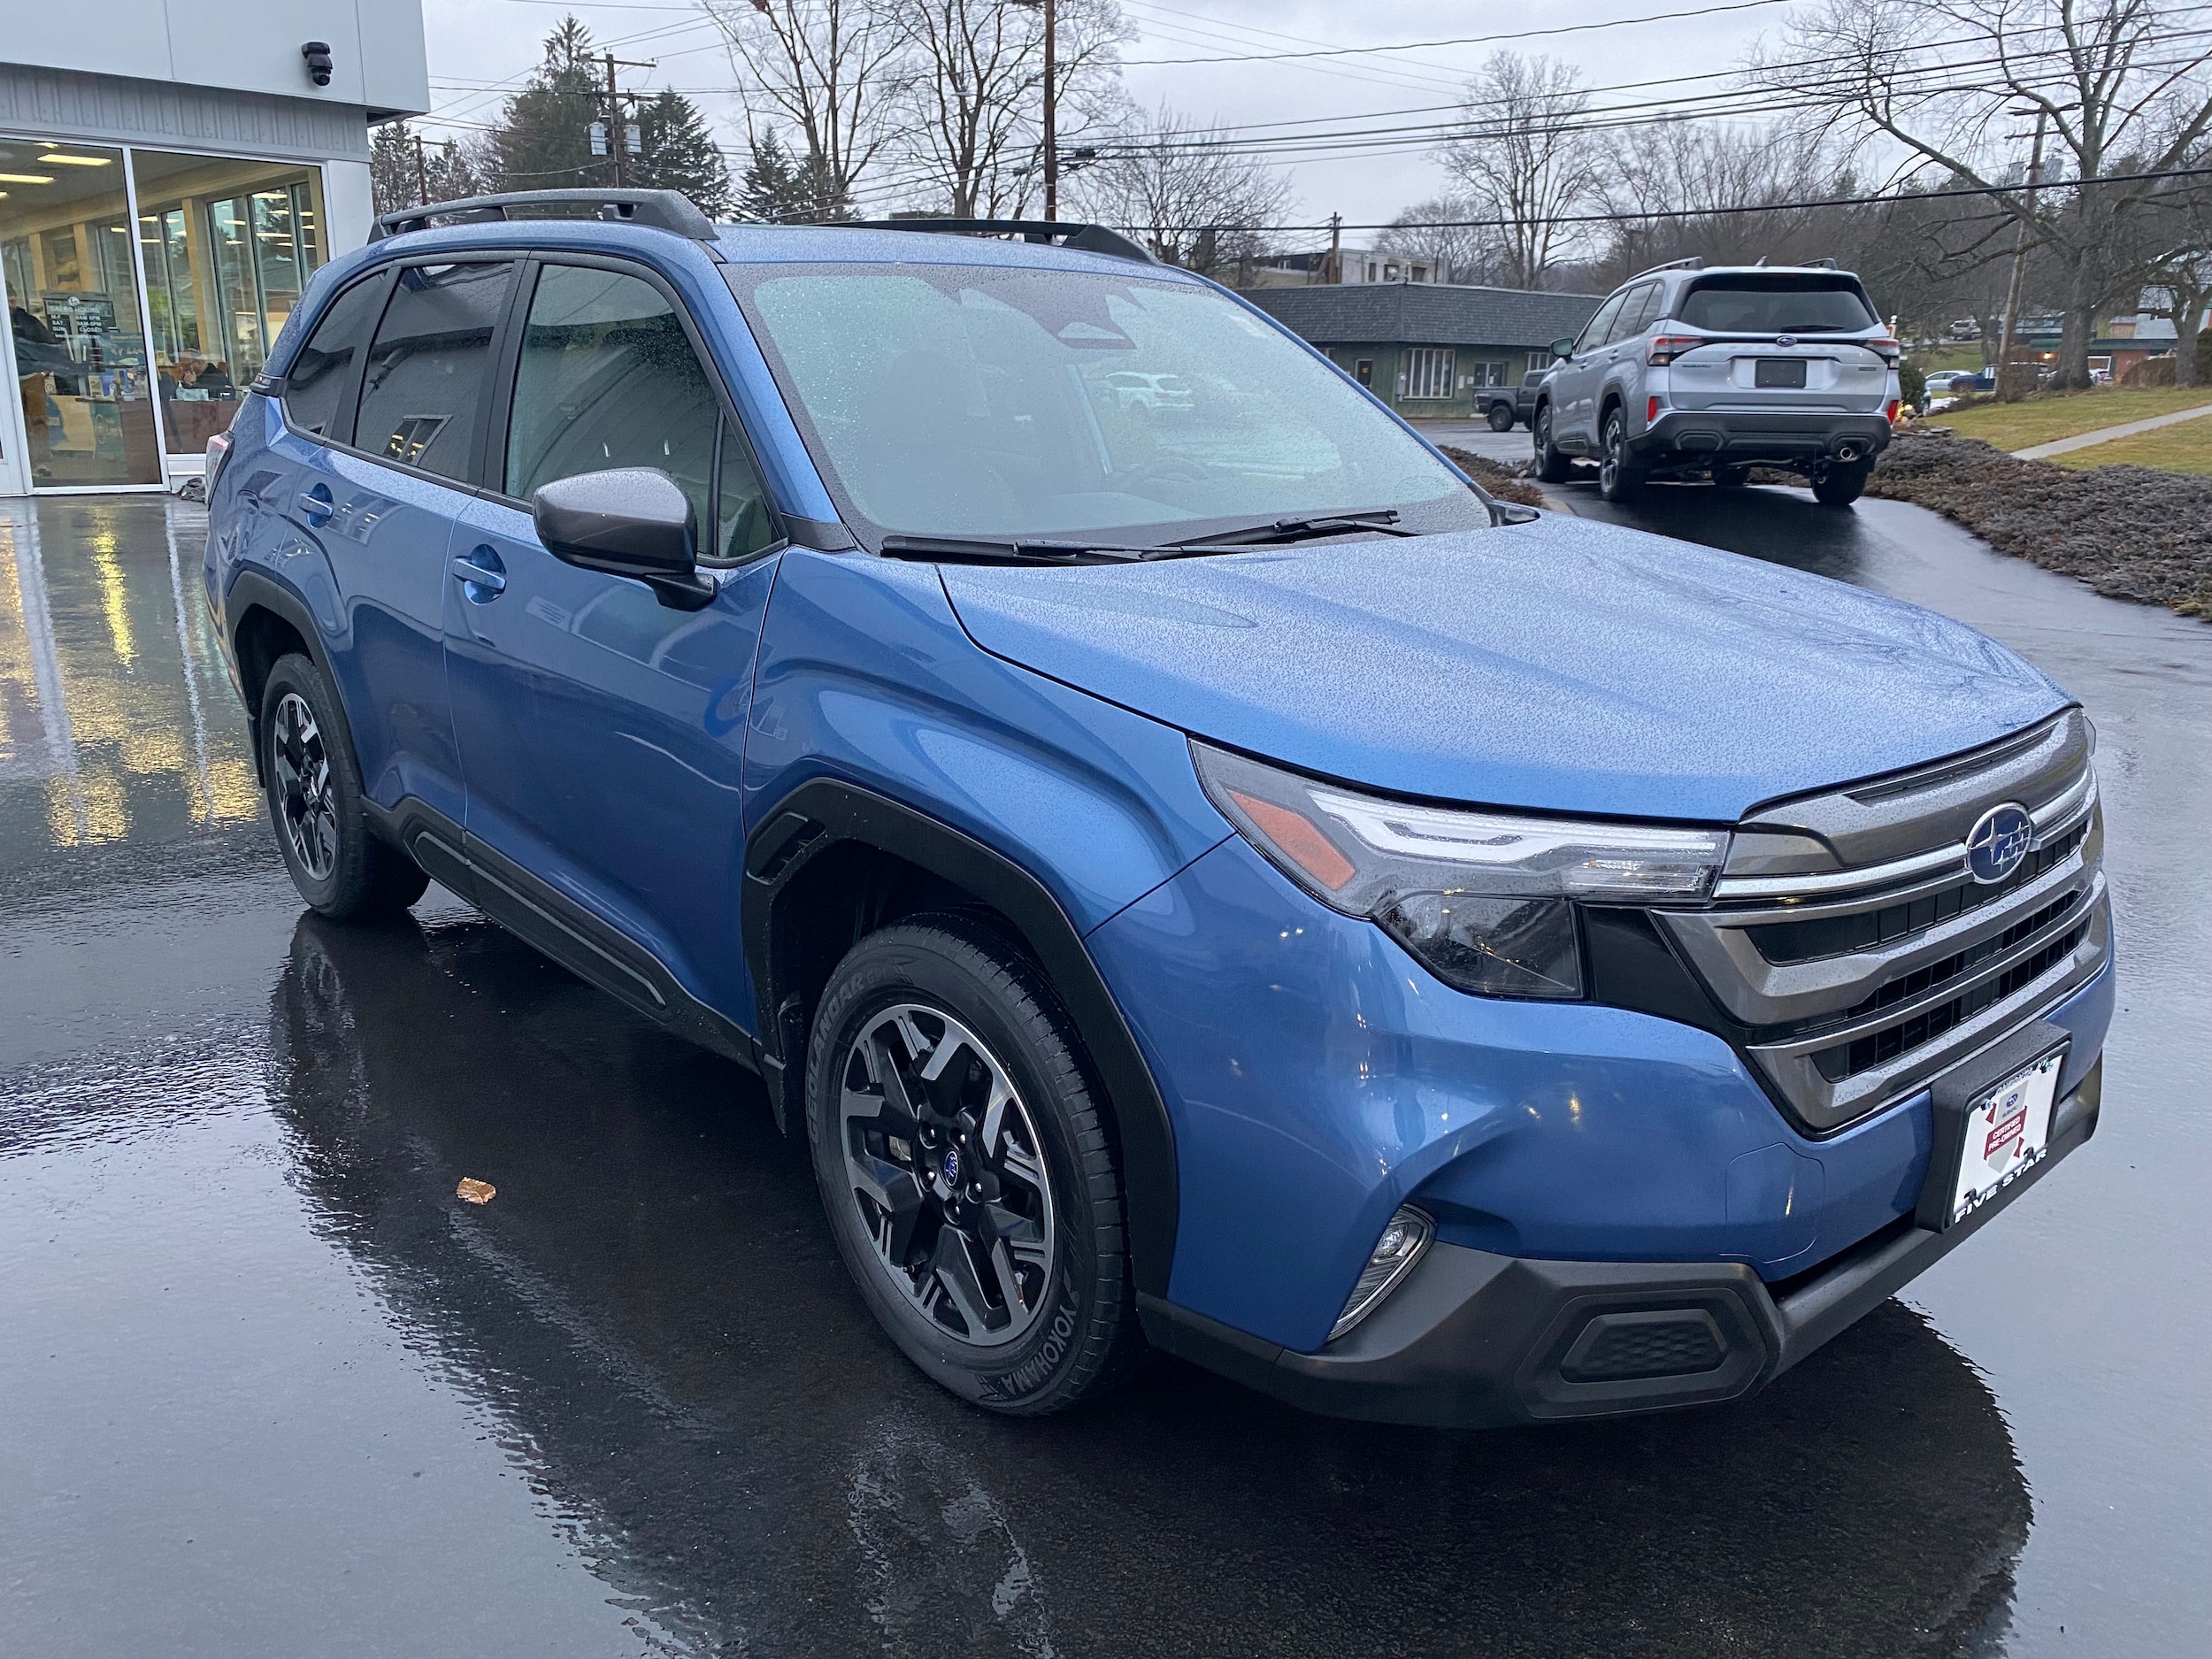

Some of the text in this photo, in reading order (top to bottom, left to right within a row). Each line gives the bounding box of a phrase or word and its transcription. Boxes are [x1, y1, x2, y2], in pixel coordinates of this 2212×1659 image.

[1988, 1123, 2022, 1151] PRE-OWNED
[1993, 1116, 2021, 1140] CERTIFIED
[1955, 1148, 2047, 1224] FIVE STAR
[1000, 1304, 1077, 1395] YOKOHAMA
